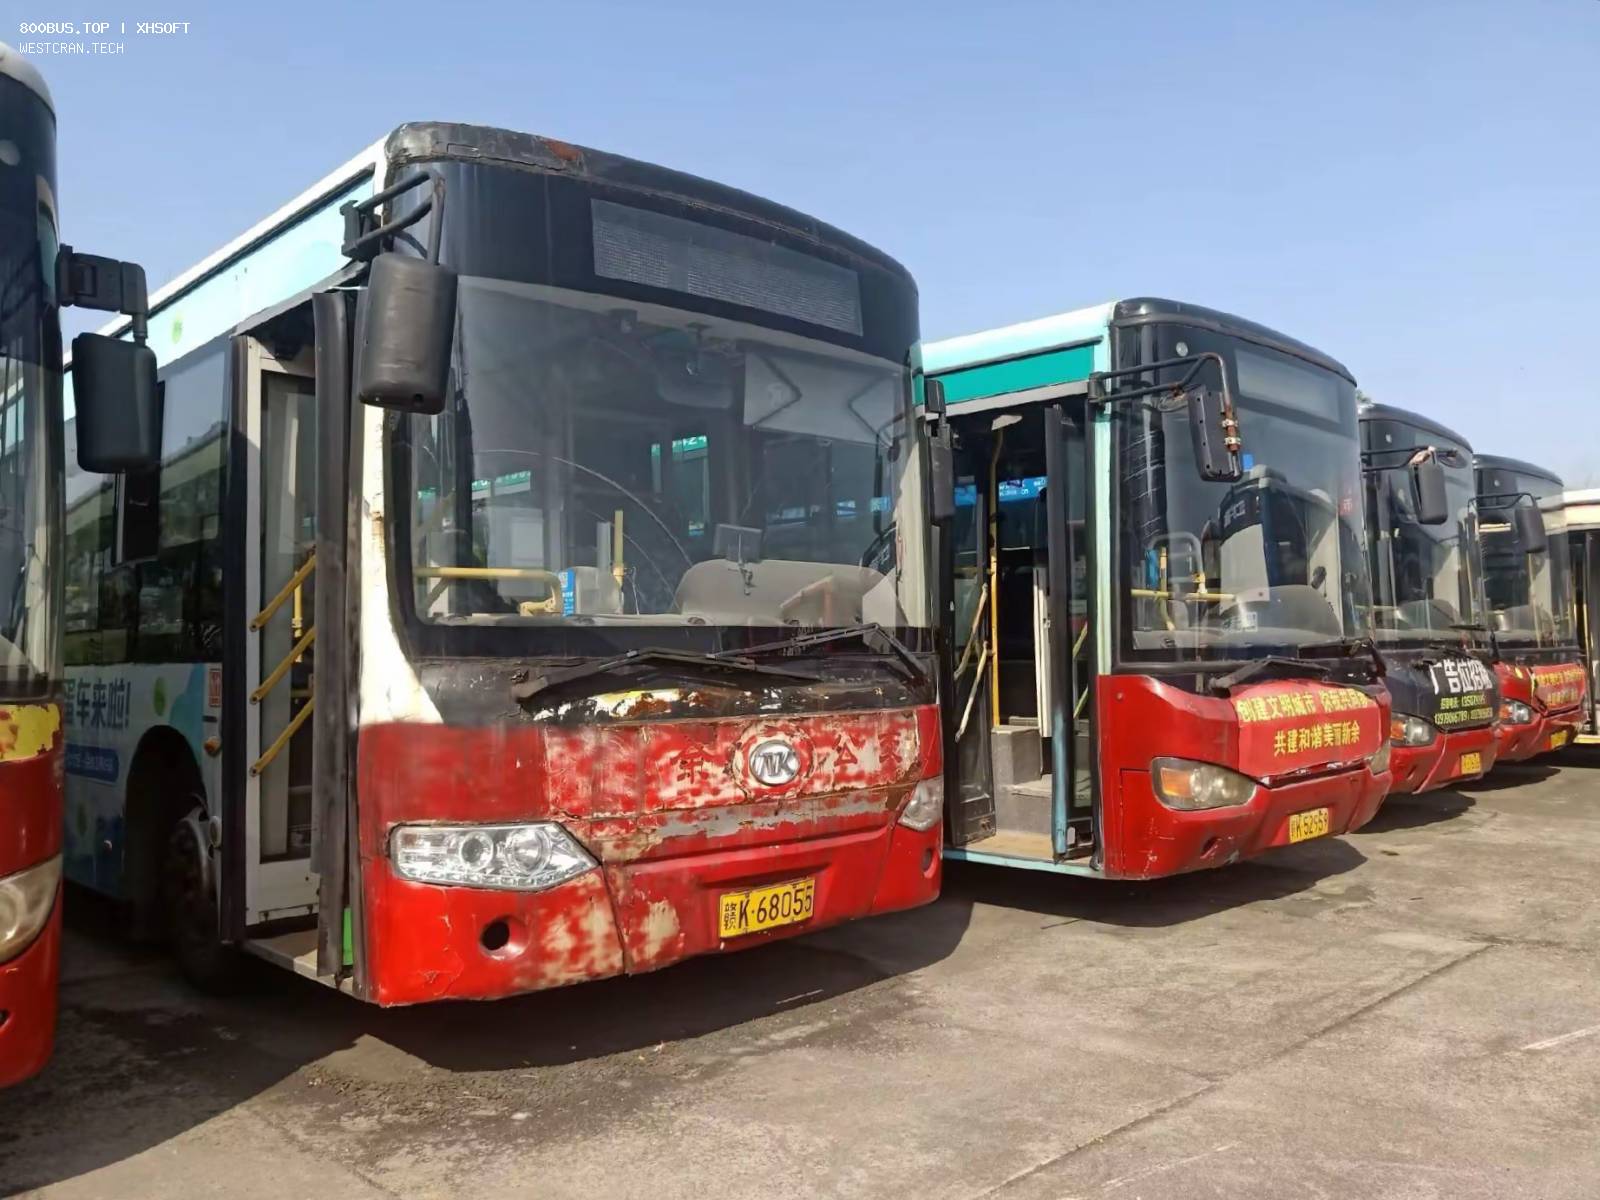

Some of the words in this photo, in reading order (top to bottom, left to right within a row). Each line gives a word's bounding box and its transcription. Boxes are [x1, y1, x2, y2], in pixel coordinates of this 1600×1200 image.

[1274, 720, 1360, 757] 共建和谐美丽新余
